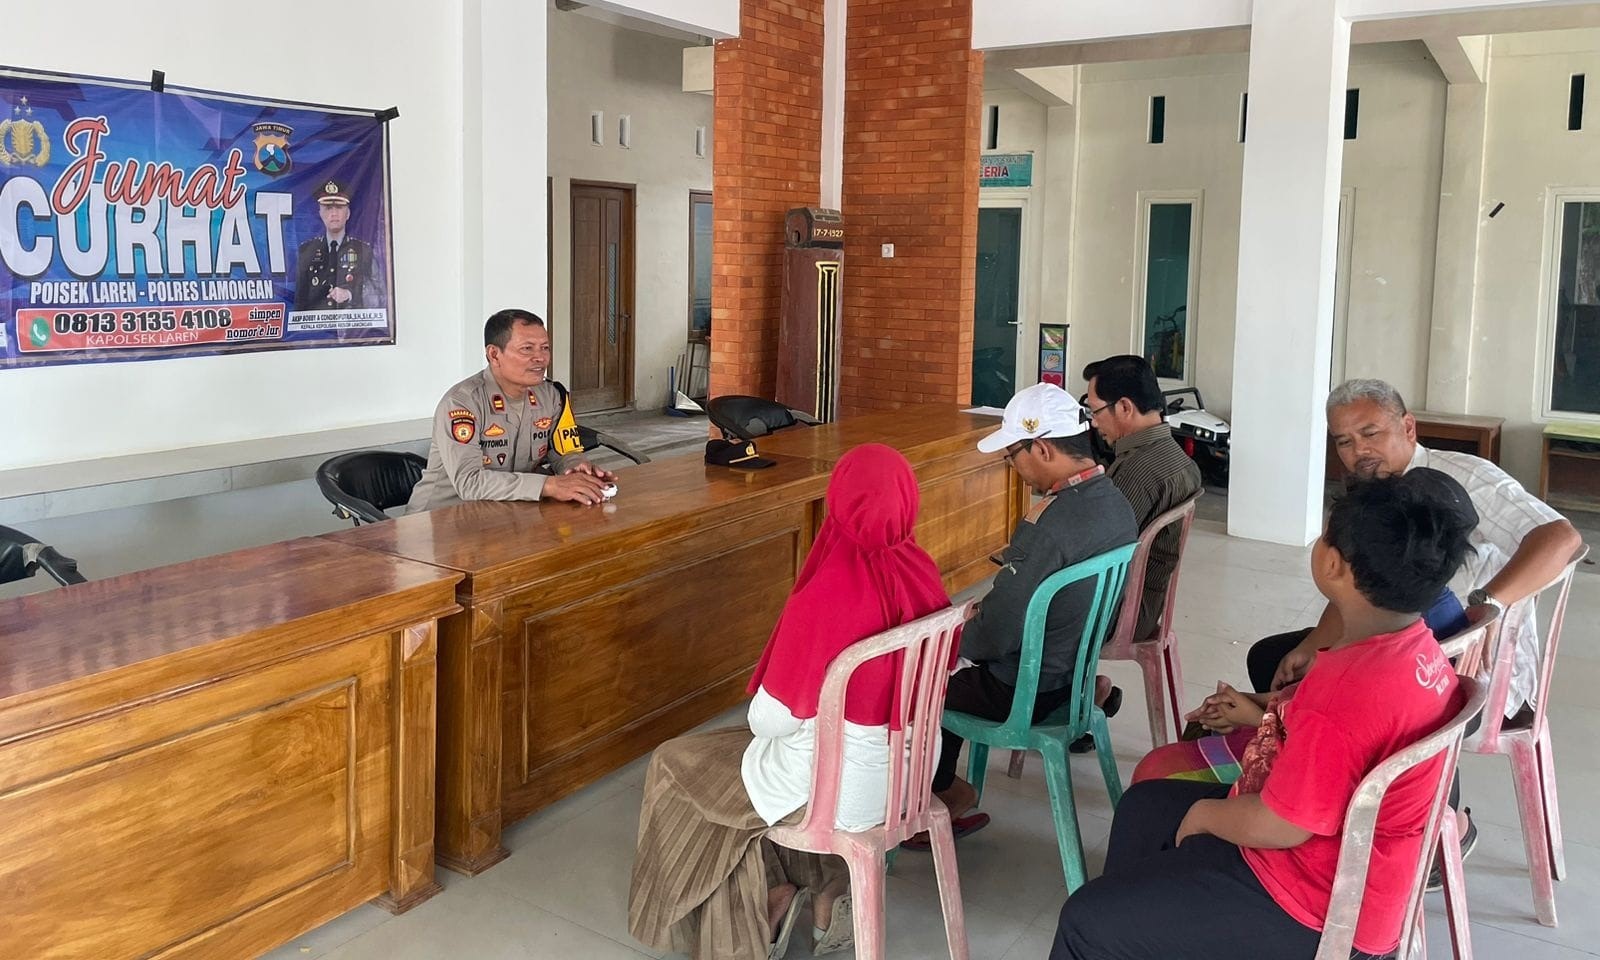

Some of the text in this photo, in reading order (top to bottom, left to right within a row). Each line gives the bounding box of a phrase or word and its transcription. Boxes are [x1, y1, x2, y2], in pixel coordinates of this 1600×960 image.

[52, 116, 246, 215] Jumat
[0, 176, 293, 277] CURHAT
[93, 281, 137, 303] LAREN
[149, 281, 199, 302] POLRES
[202, 280, 273, 301] LAMONGAN
[54, 307, 232, 334] 0813 3135 4108
[249, 308, 281, 320] simpen
[86, 331, 199, 345] KAPOLSEK LAREN
[267, 324, 280, 336] lur
